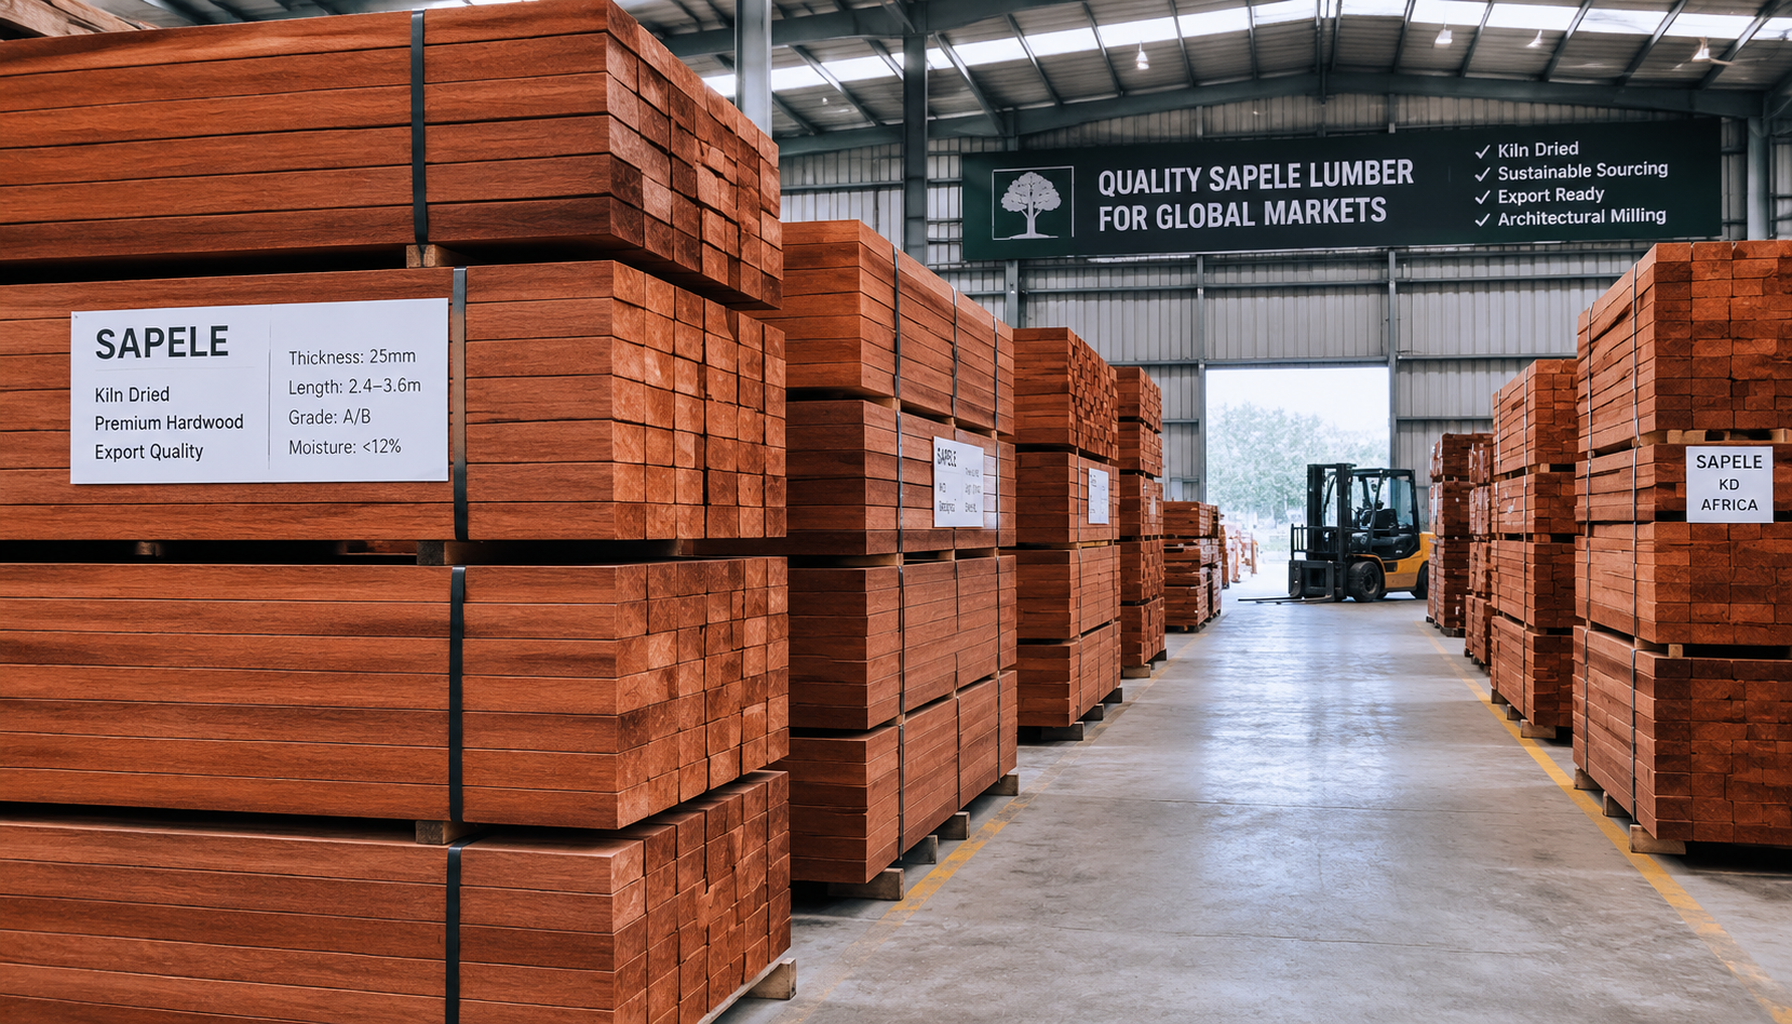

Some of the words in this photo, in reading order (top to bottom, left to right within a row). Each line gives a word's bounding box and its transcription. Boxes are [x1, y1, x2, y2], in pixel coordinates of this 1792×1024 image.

[1499, 143, 1528, 157] Kiln
[1536, 141, 1578, 156] Dried
[1099, 167, 1201, 197] QUALITY
[1209, 163, 1301, 191] SAPELE
[1310, 159, 1414, 187] LUMBER
[1499, 164, 1591, 180] Sustainable
[1597, 161, 1668, 178] Sourcing
[1499, 189, 1550, 206] Export
[1556, 186, 1604, 203] Ready
[1100, 205, 1147, 231] FOR
[1157, 202, 1255, 229] GLOBAL
[1265, 197, 1386, 225] MARKETS
[1498, 209, 1604, 226] Architectural
[1611, 208, 1666, 224] Milling
[96, 325, 228, 359] SAPELE
[289, 350, 363, 365] Thickness:
[370, 349, 415, 363] 25mm
[96, 387, 123, 402] Kiln
[130, 386, 169, 402] Dried
[290, 380, 342, 398] Length:
[96, 416, 161, 430] Premium
[167, 414, 243, 429] Hardwood
[289, 409, 337, 425] Grade:
[343, 408, 370, 425] A/B
[96, 445, 144, 462] Export
[150, 443, 203, 461] Quality
[290, 440, 356, 454] Moisture:
[363, 438, 401, 453] <12%
[1697, 455, 1762, 468] SAPELE
[1720, 479, 1739, 490] KD
[1701, 499, 1758, 510] AFRICA
